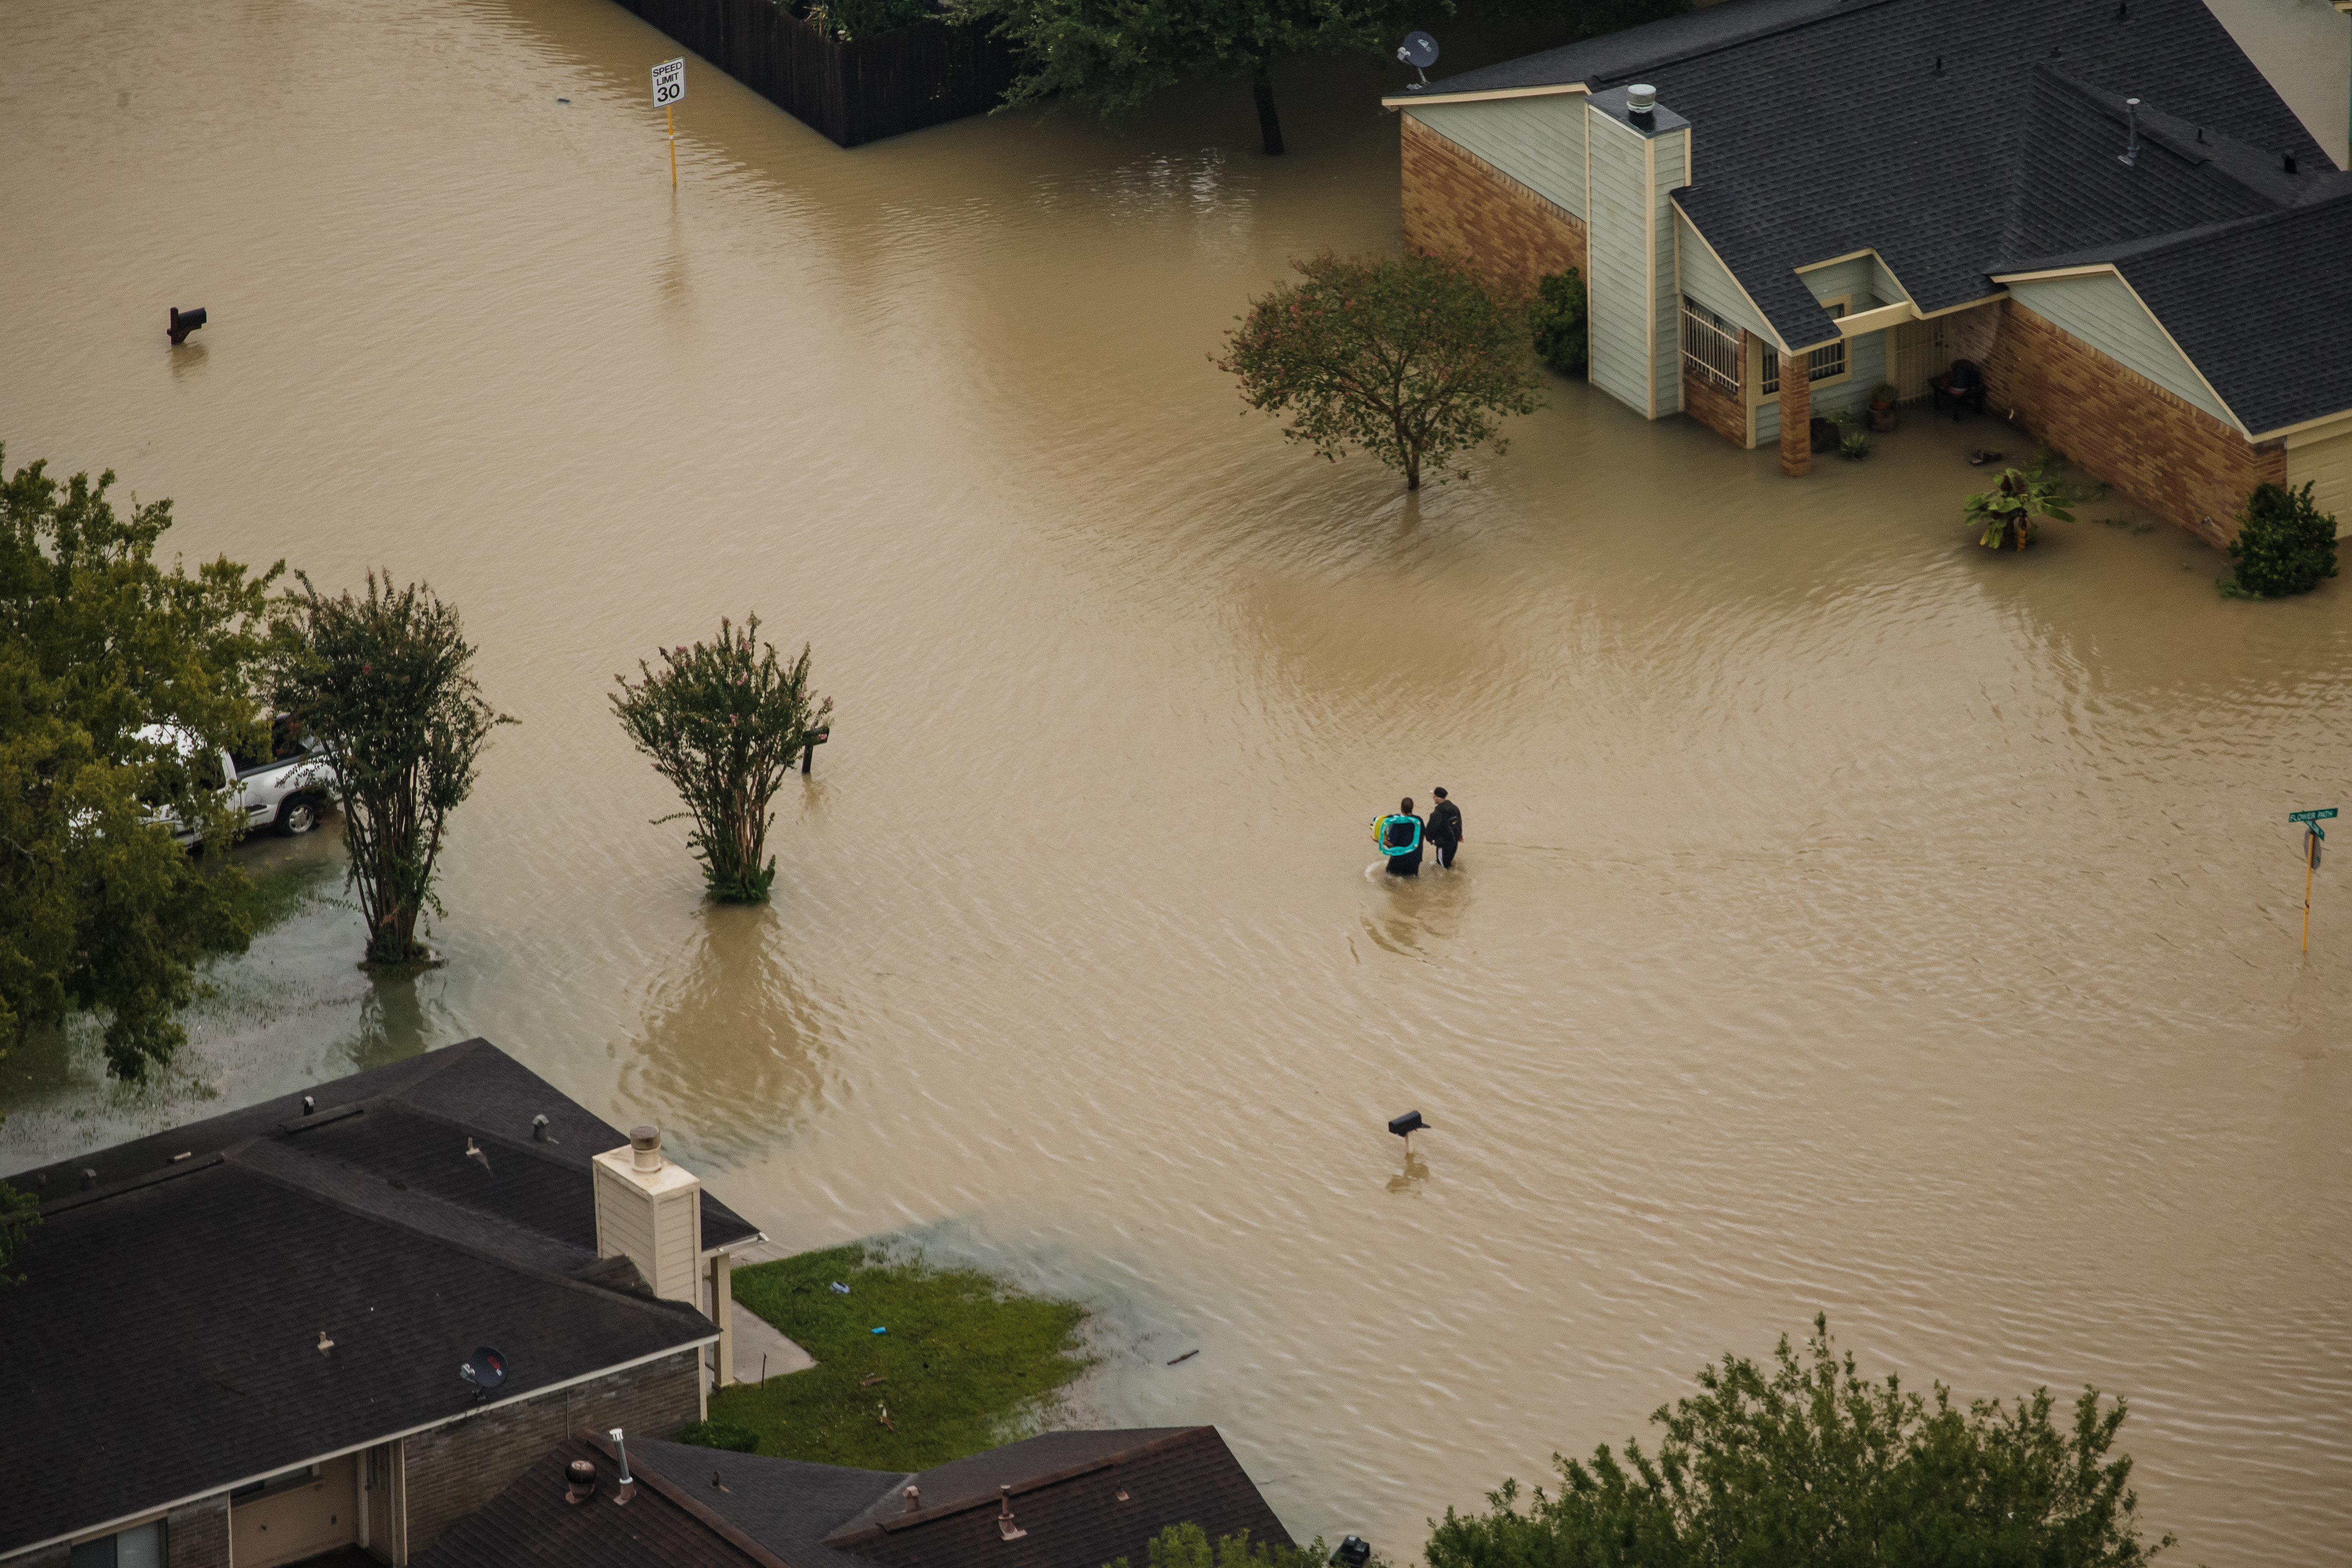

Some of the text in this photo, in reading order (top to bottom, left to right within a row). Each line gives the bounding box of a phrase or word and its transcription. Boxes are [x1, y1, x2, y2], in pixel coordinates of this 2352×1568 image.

[653, 62, 682, 77] SPEED
[657, 72, 679, 86] LIMIT
[657, 83, 680, 102] 30
[2289, 810, 2333, 822] FLOWER PATH
